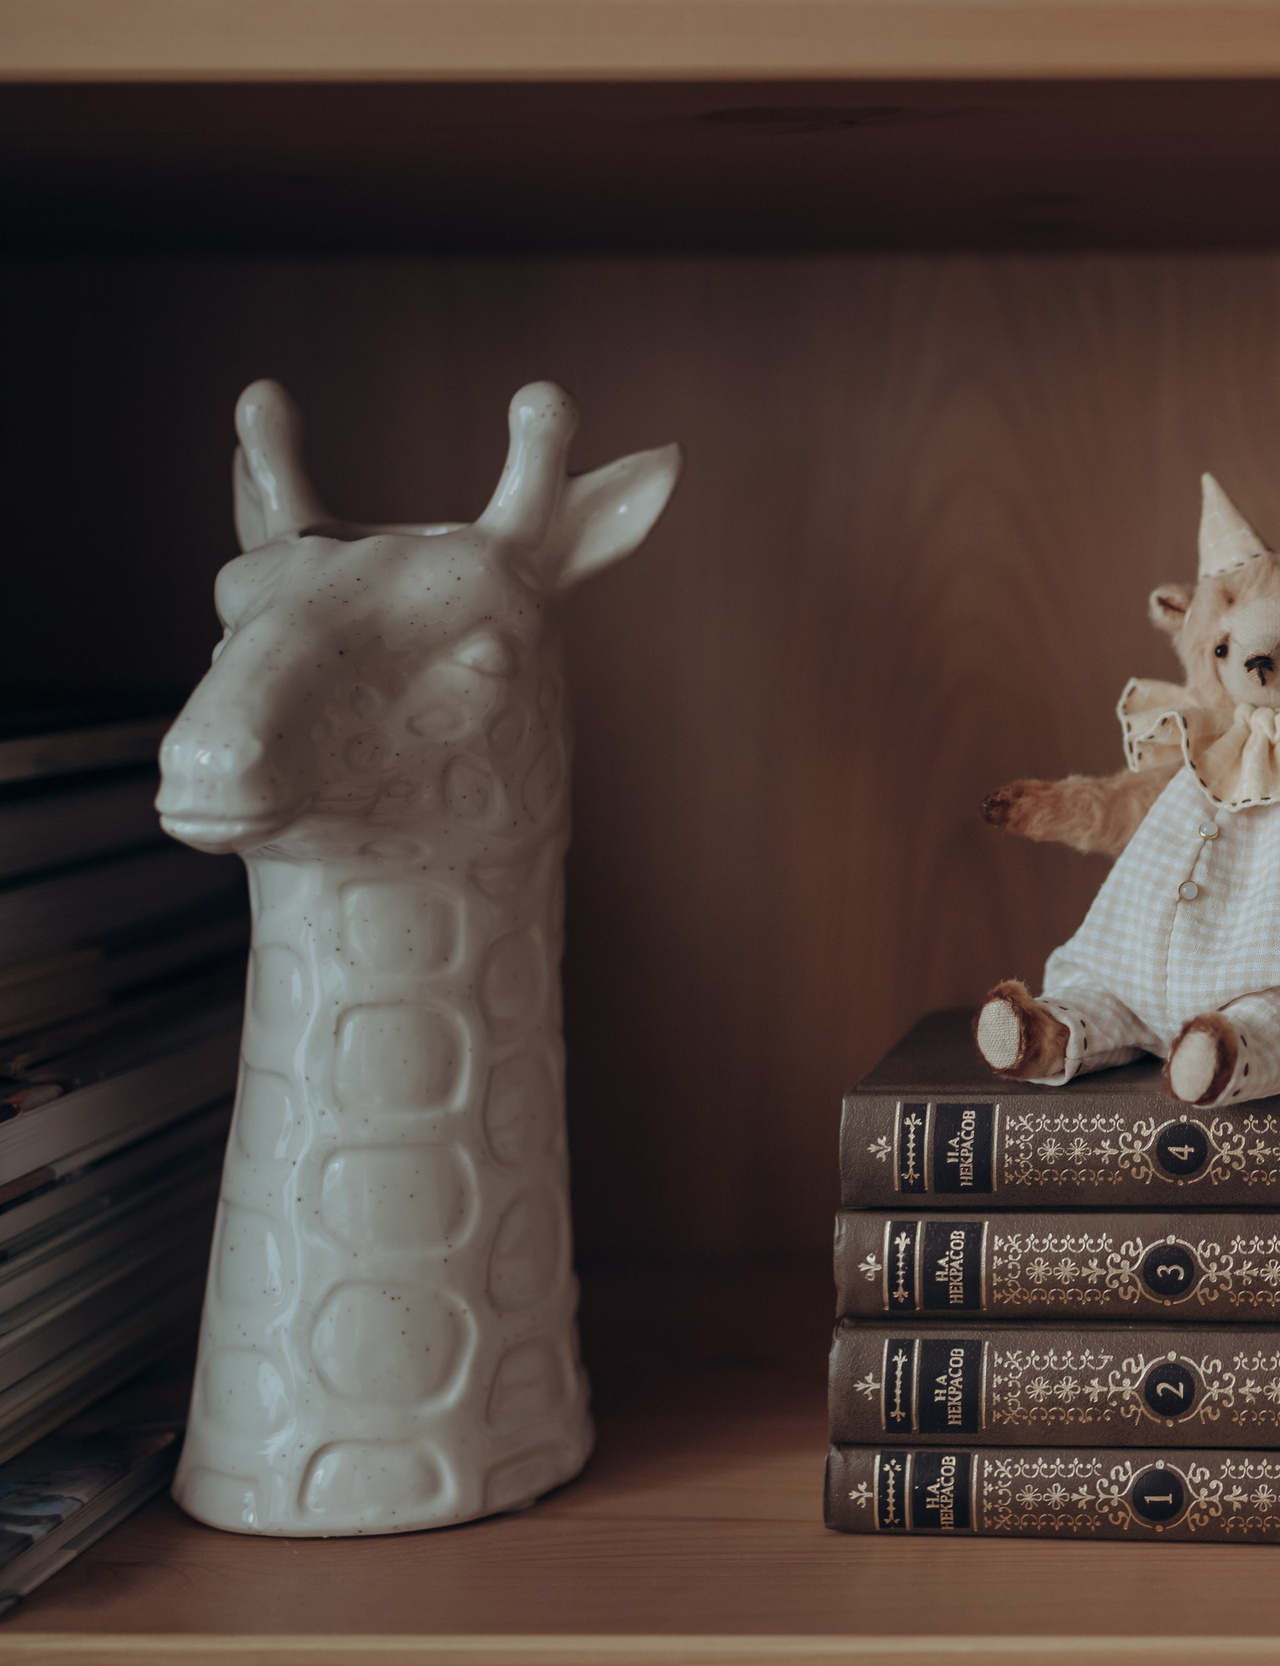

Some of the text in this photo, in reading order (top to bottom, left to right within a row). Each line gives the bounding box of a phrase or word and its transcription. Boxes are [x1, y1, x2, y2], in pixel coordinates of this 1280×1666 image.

[960, 1110, 976, 1187] НЕКРАСОВ
[1167, 1144, 1195, 1161] 4
[949, 1230, 966, 1304] НЕКРАСОВ
[1157, 1264, 1185, 1281] 3
[947, 1348, 965, 1426] НЕКРАСОВ
[1156, 1381, 1184, 1399] 2
[940, 1455, 957, 1530] НЕКРАСОВ
[1144, 1493, 1173, 1505] 1
